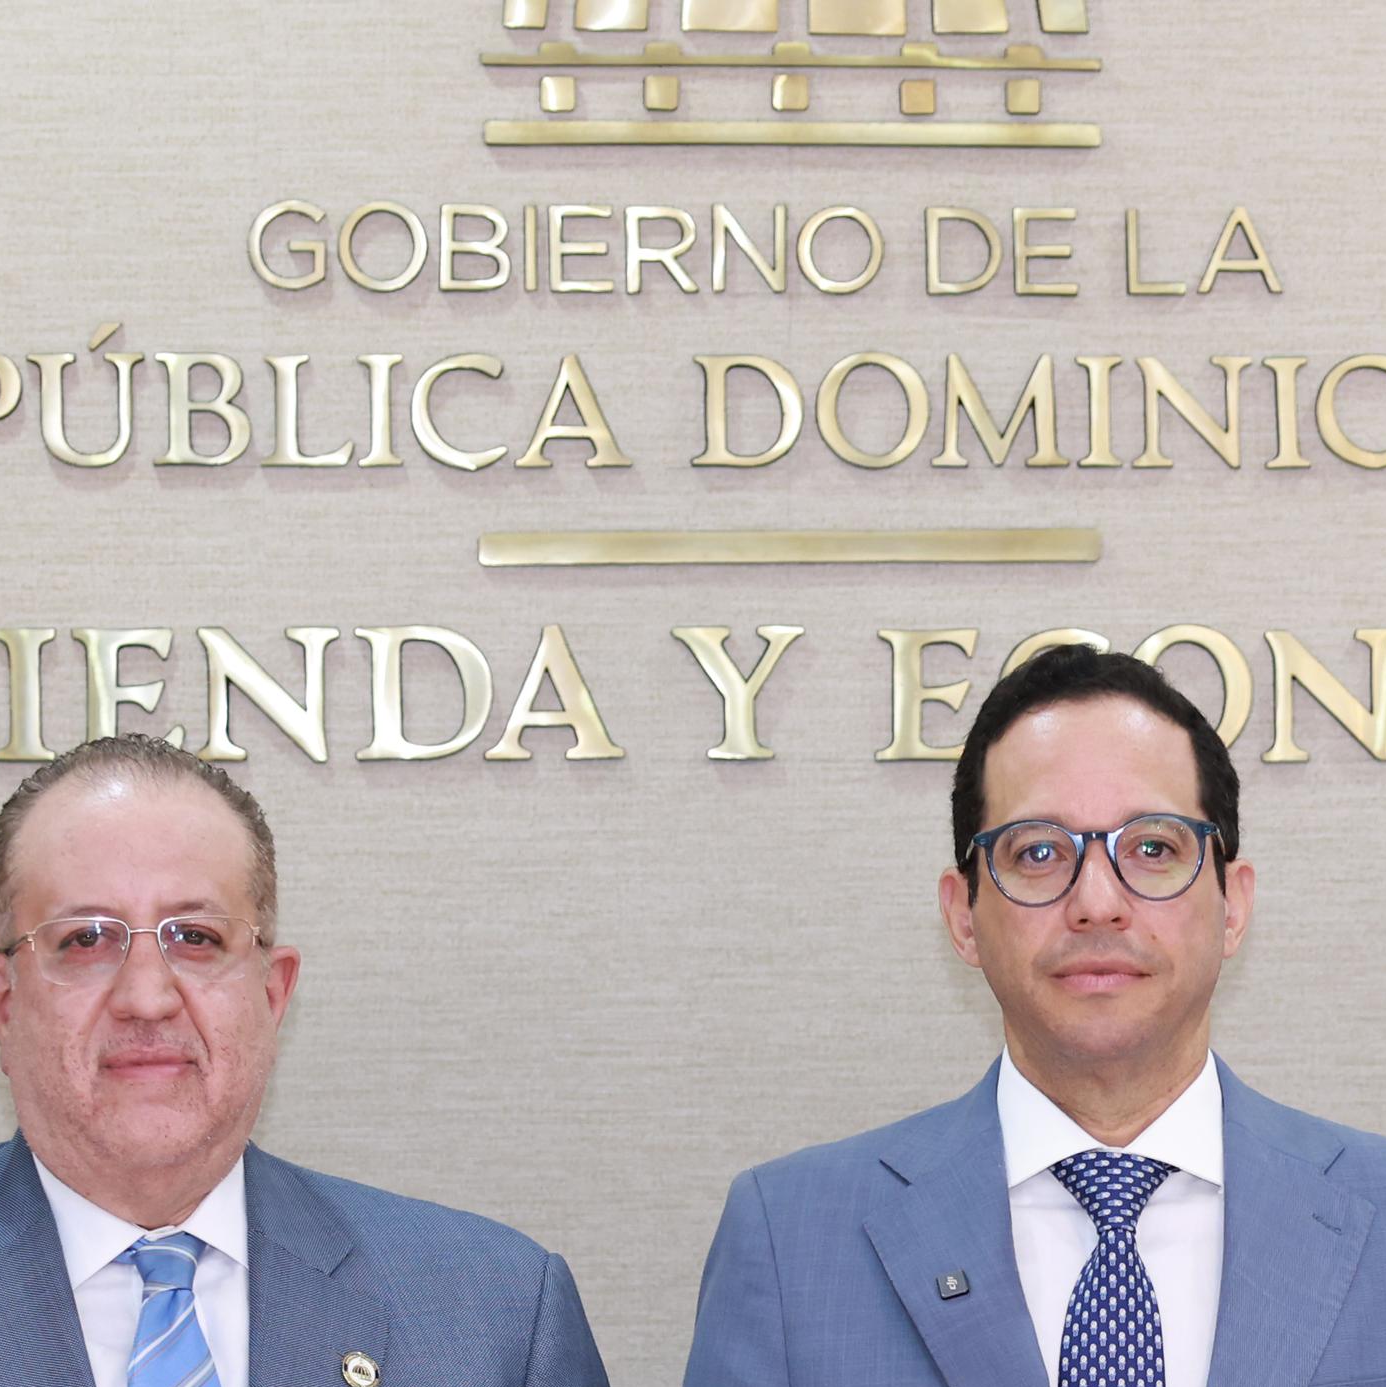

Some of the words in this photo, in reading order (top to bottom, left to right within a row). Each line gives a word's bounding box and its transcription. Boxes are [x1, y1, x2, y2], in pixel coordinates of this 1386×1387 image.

[248, 199, 884, 295] GOBIERNO
[925, 206, 1080, 296] DE
[1125, 206, 1283, 296] LA
[670, 624, 806, 762] Y
